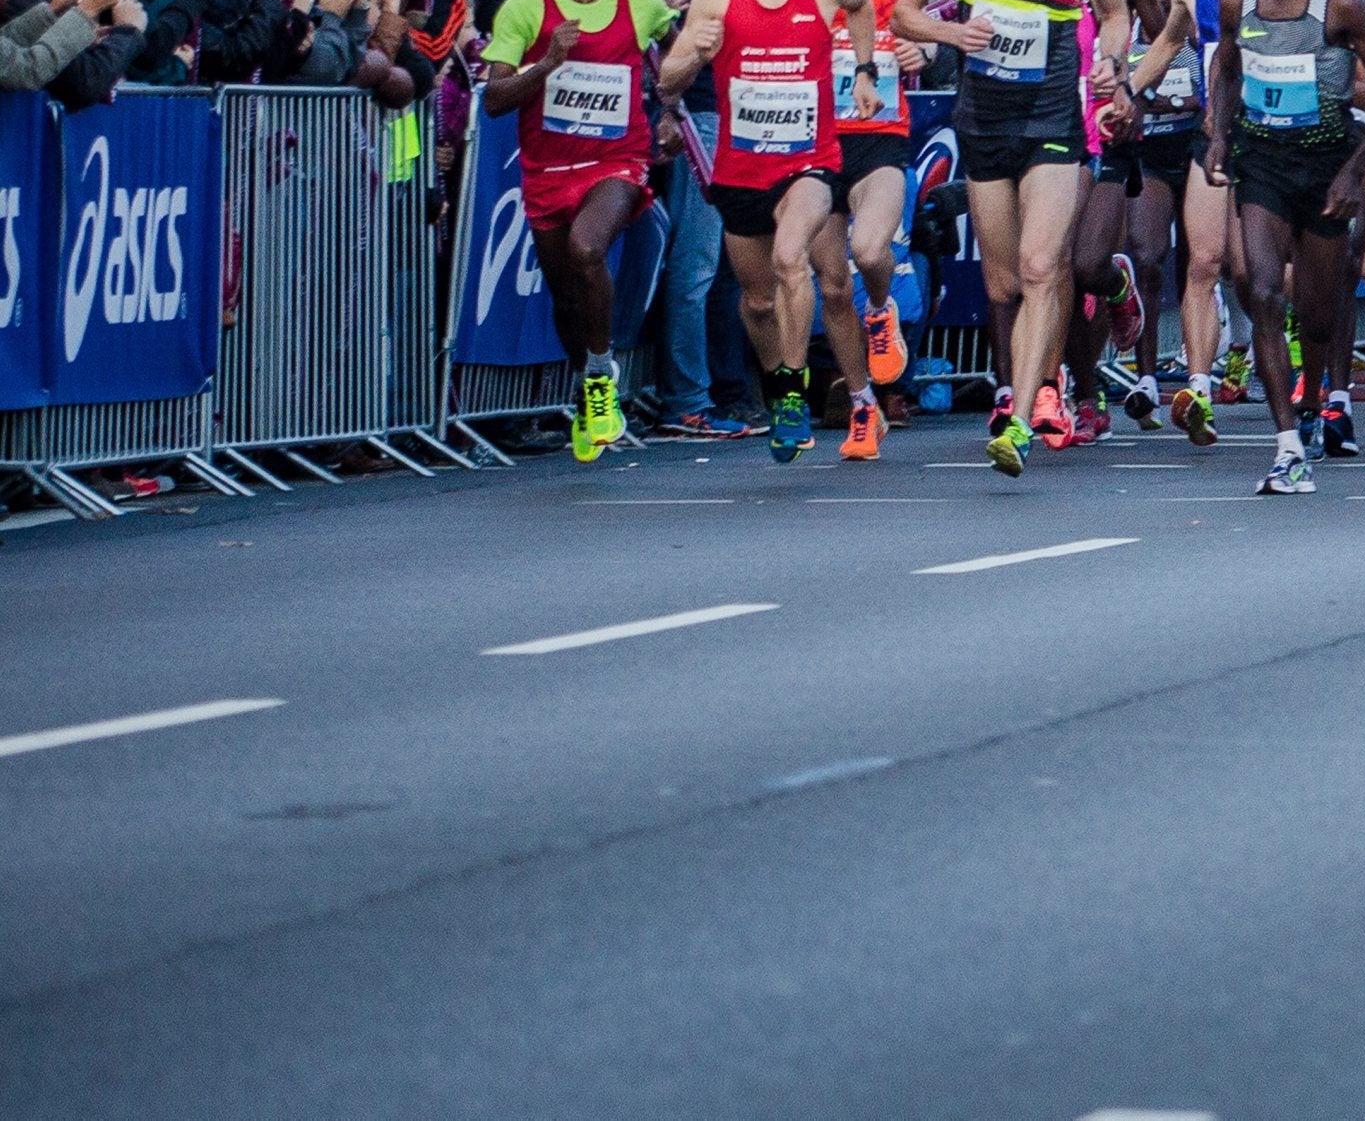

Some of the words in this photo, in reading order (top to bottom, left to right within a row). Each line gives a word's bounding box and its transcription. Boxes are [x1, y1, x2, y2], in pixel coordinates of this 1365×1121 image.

[988, 33, 1037, 57] OBBY
[552, 88, 623, 112] DEMEKE
[1264, 88, 1284, 110] 97
[737, 106, 803, 125] ANDREAS
